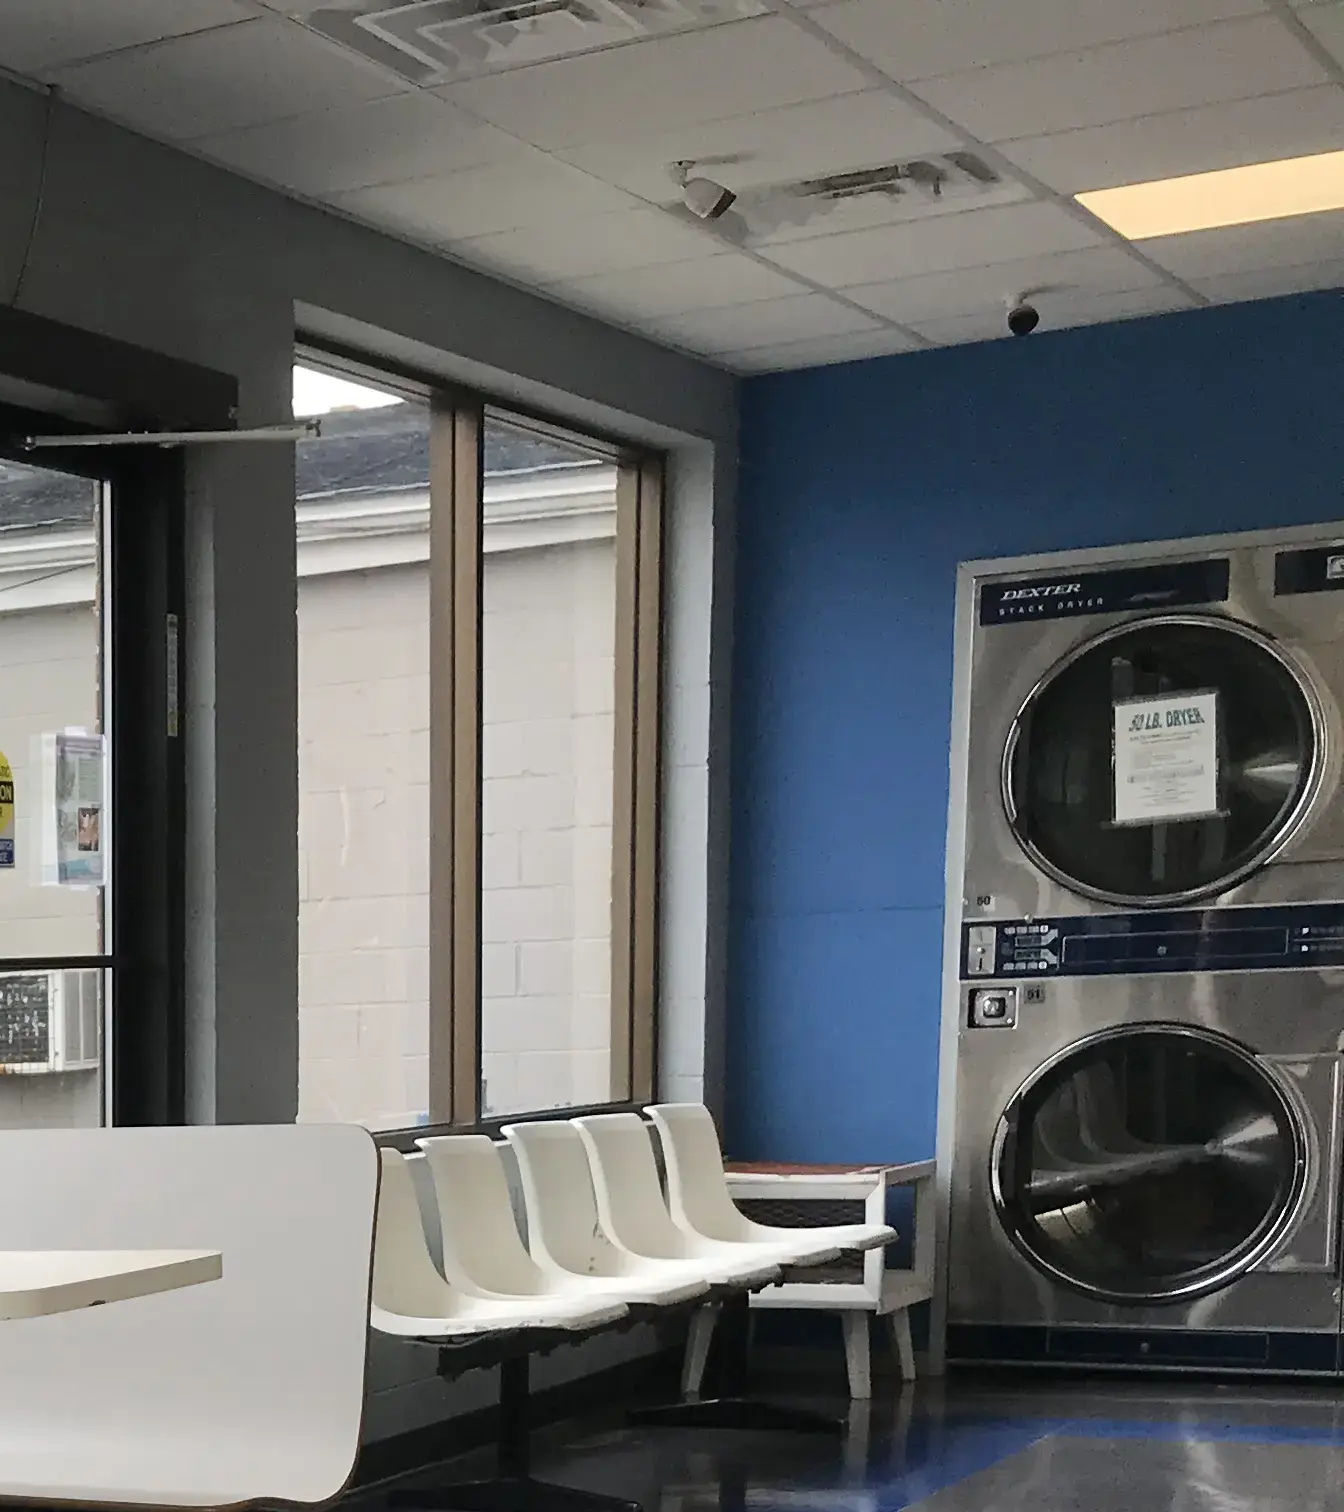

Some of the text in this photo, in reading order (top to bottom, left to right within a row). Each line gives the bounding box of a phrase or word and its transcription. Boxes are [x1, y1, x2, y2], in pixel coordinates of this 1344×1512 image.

[1000, 583, 1081, 601] DEXTER
[999, 597, 1103, 616] STACK DRYER
[1166, 706, 1205, 728] DRYER
